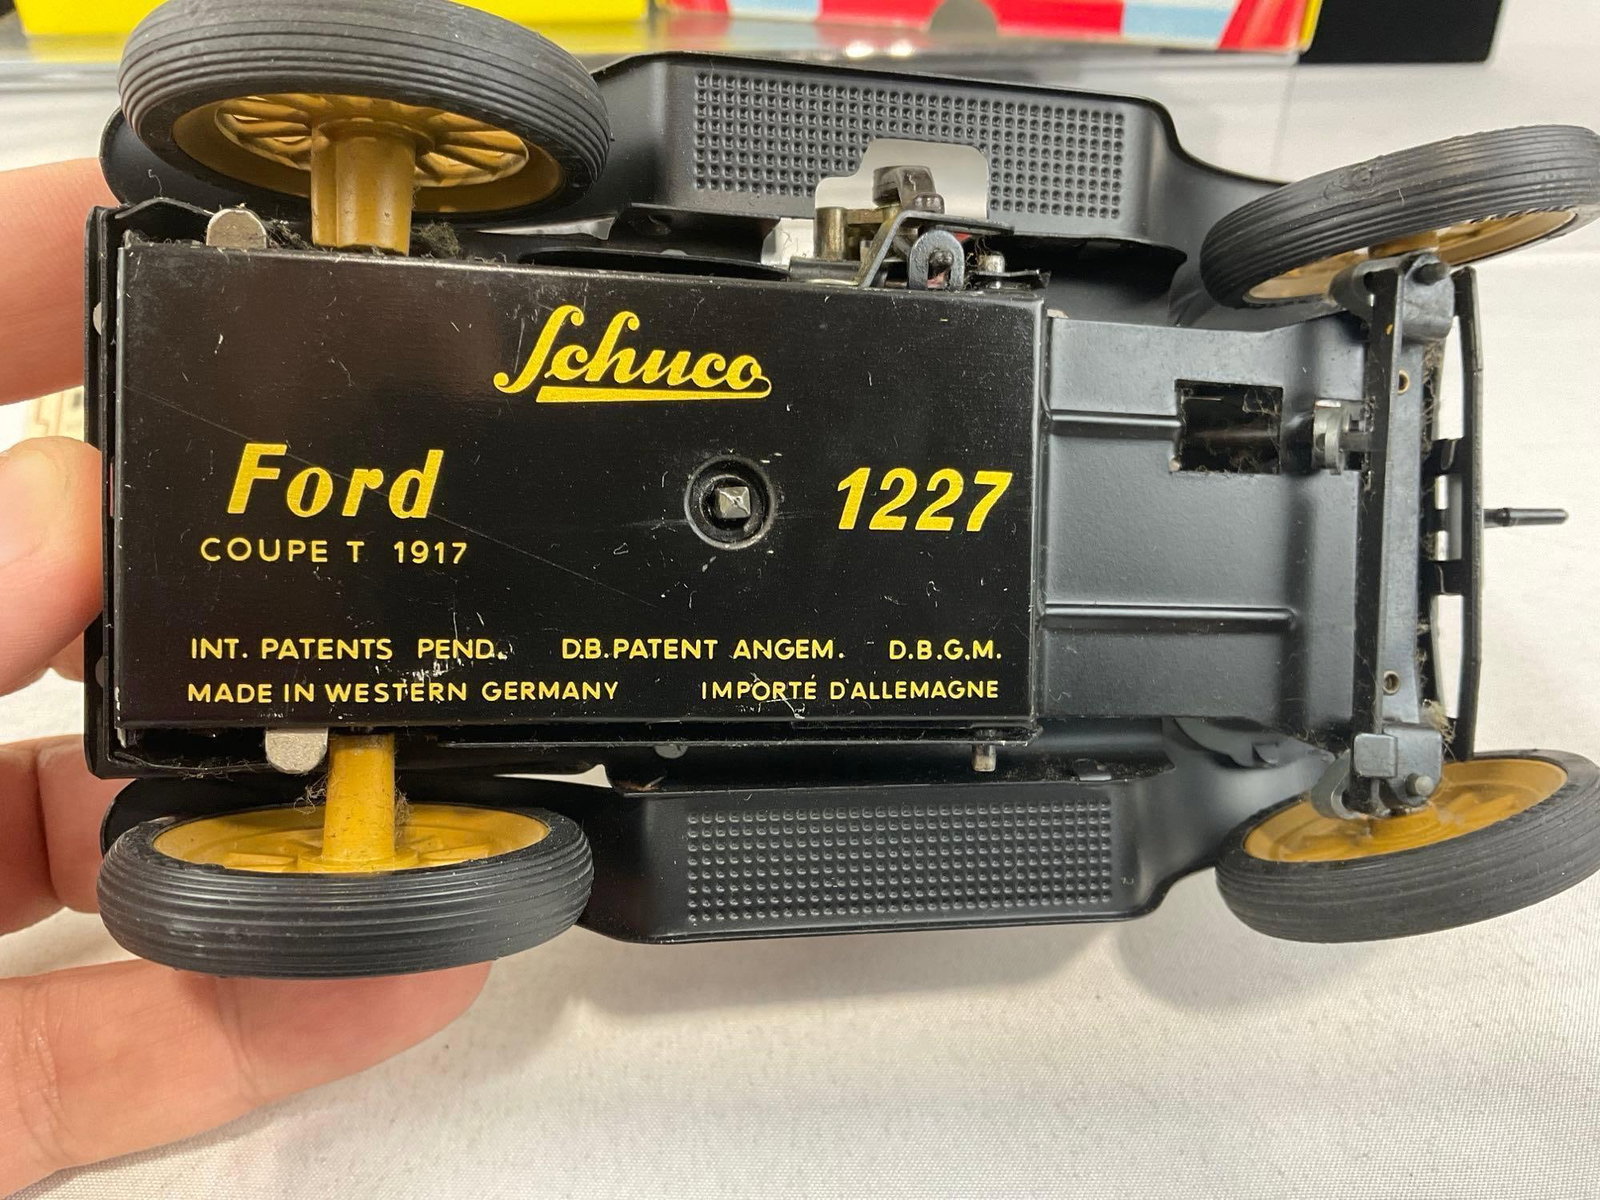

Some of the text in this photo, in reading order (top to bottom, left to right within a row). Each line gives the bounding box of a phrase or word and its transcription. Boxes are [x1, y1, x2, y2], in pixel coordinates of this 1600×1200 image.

[492, 303, 773, 404] Schuco
[226, 439, 445, 520] Ford
[837, 466, 1014, 532] 1227
[200, 537, 468, 564] COUPE T 1917
[191, 638, 507, 660] INT. PATENTS PEND.
[733, 639, 846, 660] ANGEM.
[888, 640, 1002, 661] D.B.G.M.
[187, 681, 619, 703] MADE IN WESTERN GERMANY
[701, 676, 999, 701] IMPORTÉ D'ALLEMAGNE
